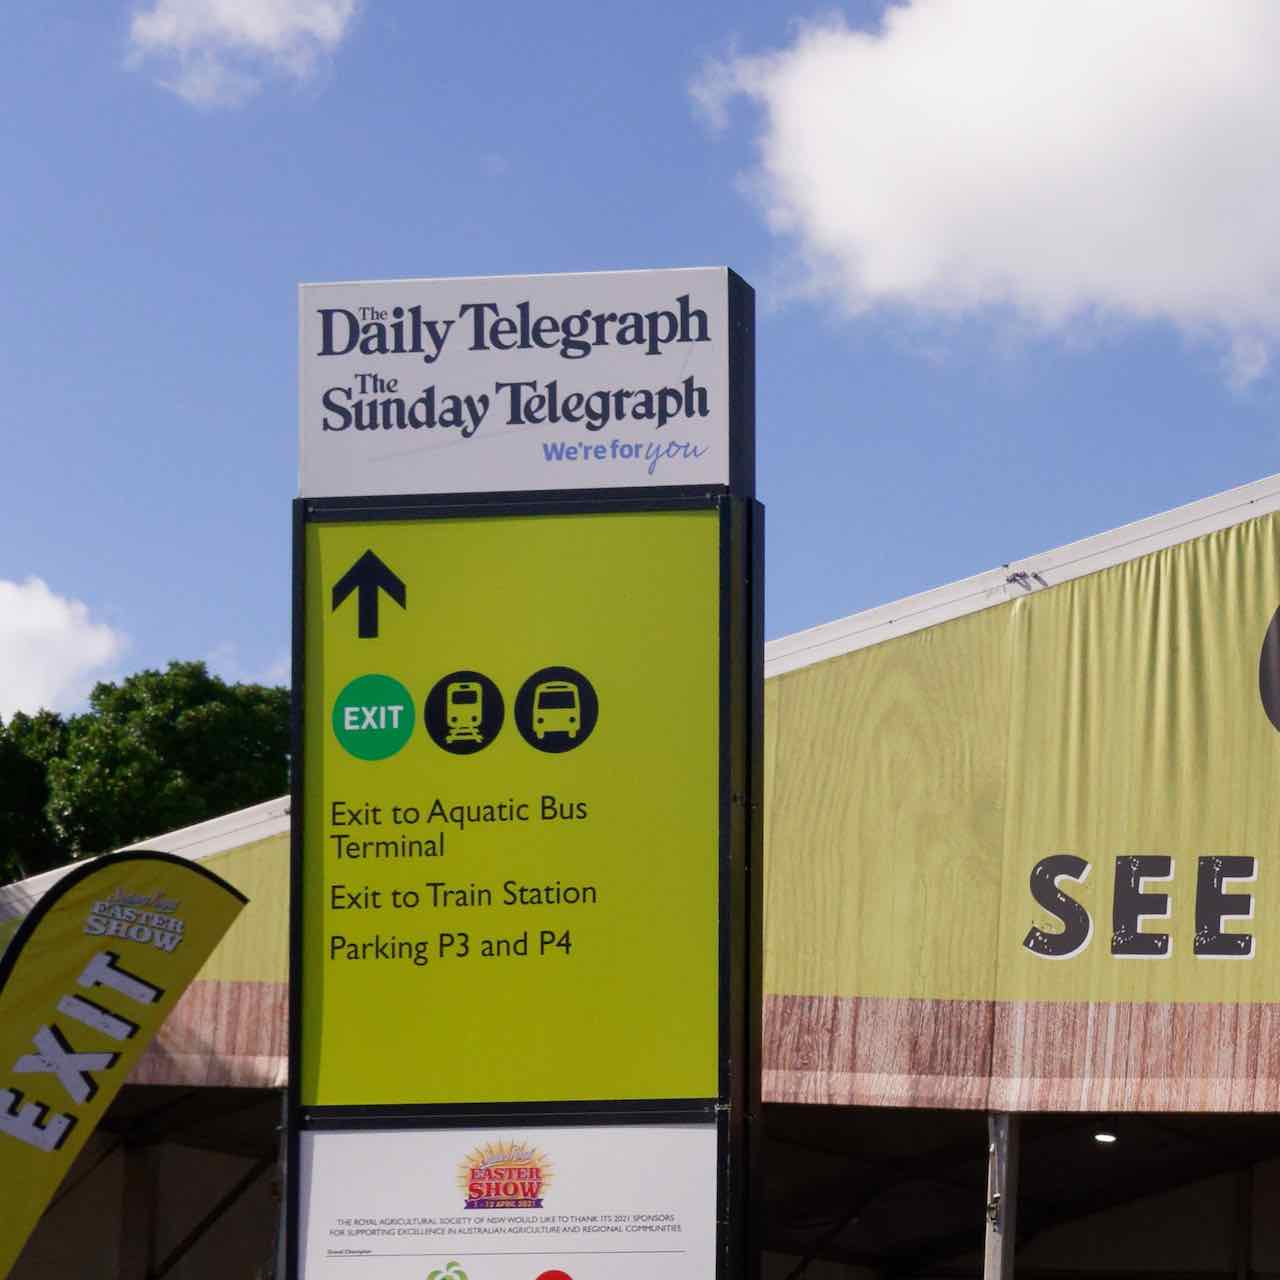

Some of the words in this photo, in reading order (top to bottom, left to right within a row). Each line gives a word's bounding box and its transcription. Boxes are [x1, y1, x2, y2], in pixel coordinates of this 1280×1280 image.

[358, 306, 388, 322] The
[459, 294, 711, 359] Telegraph
[316, 304, 455, 364] Daily
[354, 373, 398, 395] The
[322, 385, 489, 438] Sunday
[495, 376, 711, 431] Telegraph
[542, 441, 607, 461] We're
[610, 439, 644, 459] for
[644, 440, 710, 475] you
[343, 705, 404, 731] EXIT
[331, 801, 383, 826] Exit
[391, 804, 420, 824] to
[426, 798, 529, 830] Aquatic
[541, 795, 588, 821] Bus
[331, 832, 445, 859] Terminal
[331, 885, 382, 910] Exit
[391, 886, 420, 908] to
[426, 882, 493, 908] Train
[503, 880, 597, 906] Station
[1023, 855, 1257, 961] SEE
[91, 901, 184, 932] EASTER
[84, 915, 183, 952] SHOW
[330, 934, 429, 966] Parking
[438, 933, 470, 959] P3
[480, 931, 529, 957] and
[539, 930, 572, 956] P4
[0, 951, 165, 1153] EXIT
[470, 1168, 541, 1180] EASTER
[468, 1182, 544, 1200] SHOW
[329, 1228, 345, 1236] FOR
[347, 1228, 396, 1236] SUPPORTING
[458, 1226, 506, 1234] AUSTRALIAN
[562, 1225, 581, 1233] AND
[582, 1224, 623, 1232] REGIONAL
[625, 1224, 682, 1232] COMMUNITIES
[439, 1216, 472, 1225] SOCIETY
[558, 1215, 568, 1223] TO
[633, 1214, 675, 1222] SPONSORS
